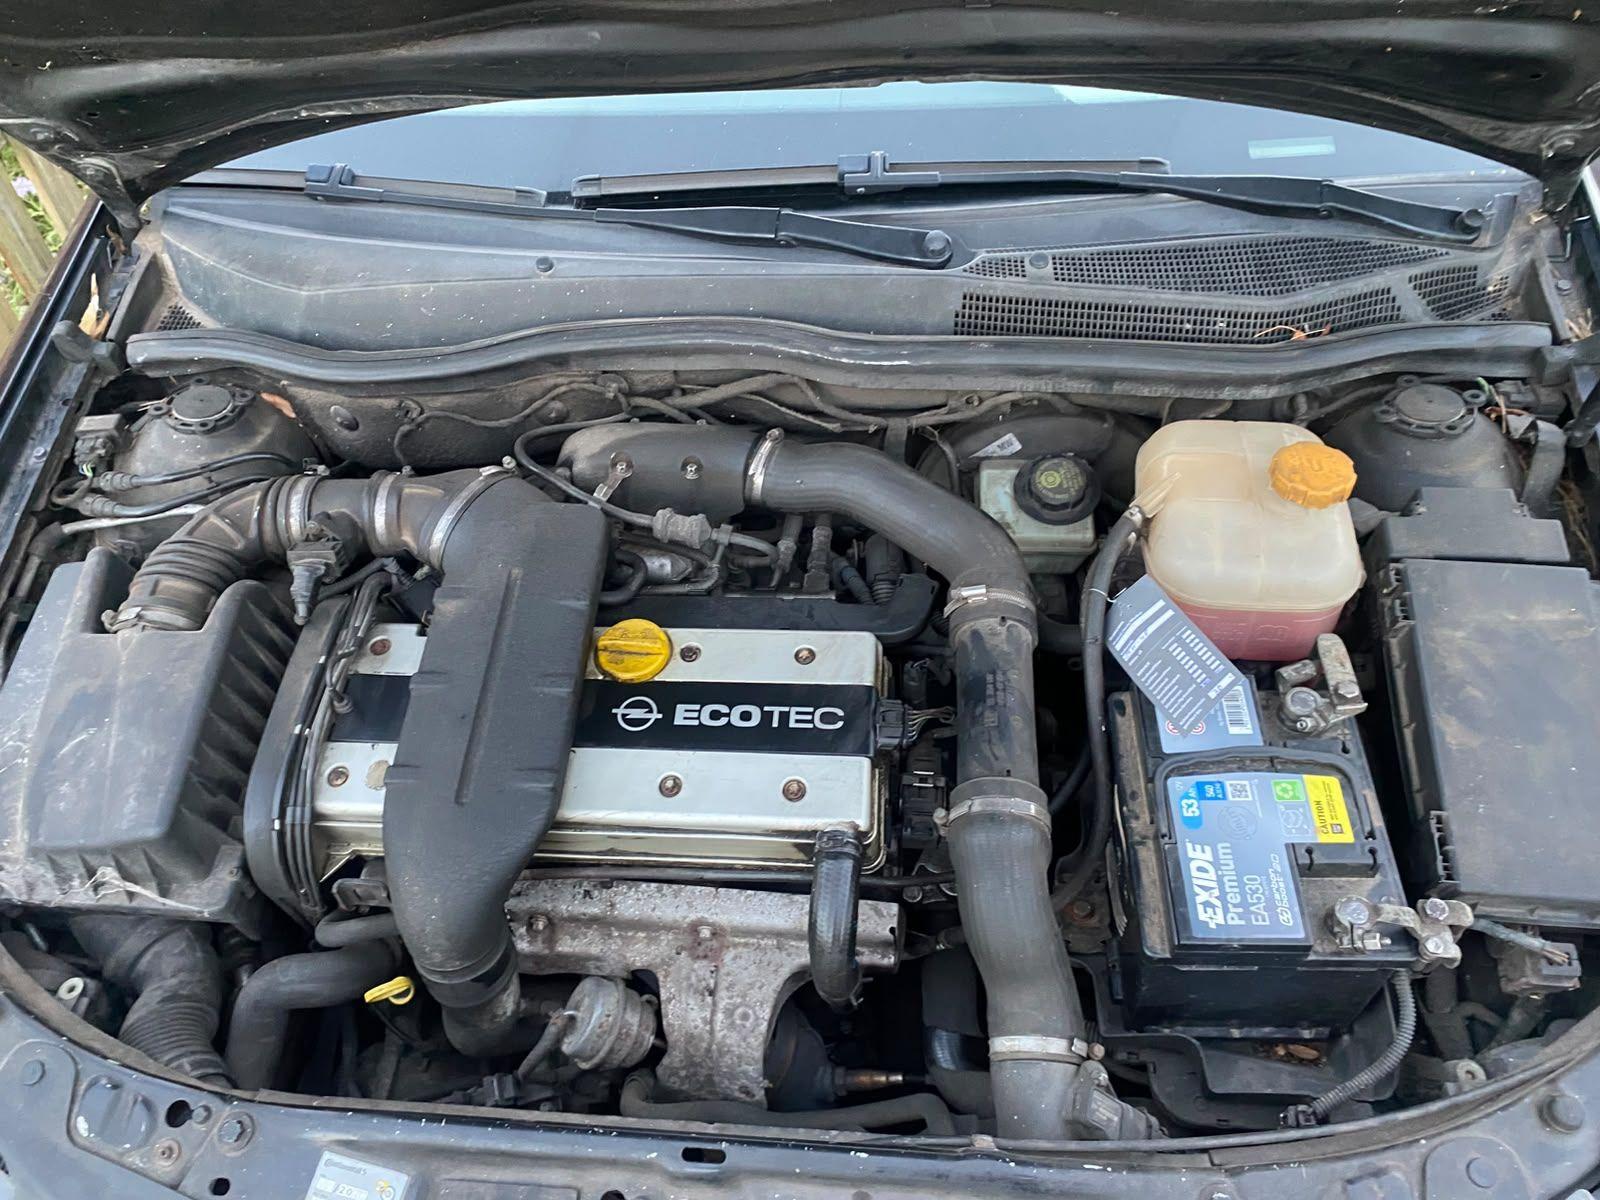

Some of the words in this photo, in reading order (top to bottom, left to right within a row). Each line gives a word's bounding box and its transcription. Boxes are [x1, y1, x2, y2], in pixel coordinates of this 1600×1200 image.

[673, 704, 845, 730] ECOTEC
[1181, 799, 1200, 817] 53
[1204, 784, 1215, 798] 540
[1313, 800, 1330, 835] CAUTION
[1185, 842, 1226, 929] EXIDE
[1217, 842, 1246, 925] Premium
[1243, 875, 1270, 926] EA530
[1268, 868, 1282, 907] carbon
[1276, 877, 1290, 908] boost
